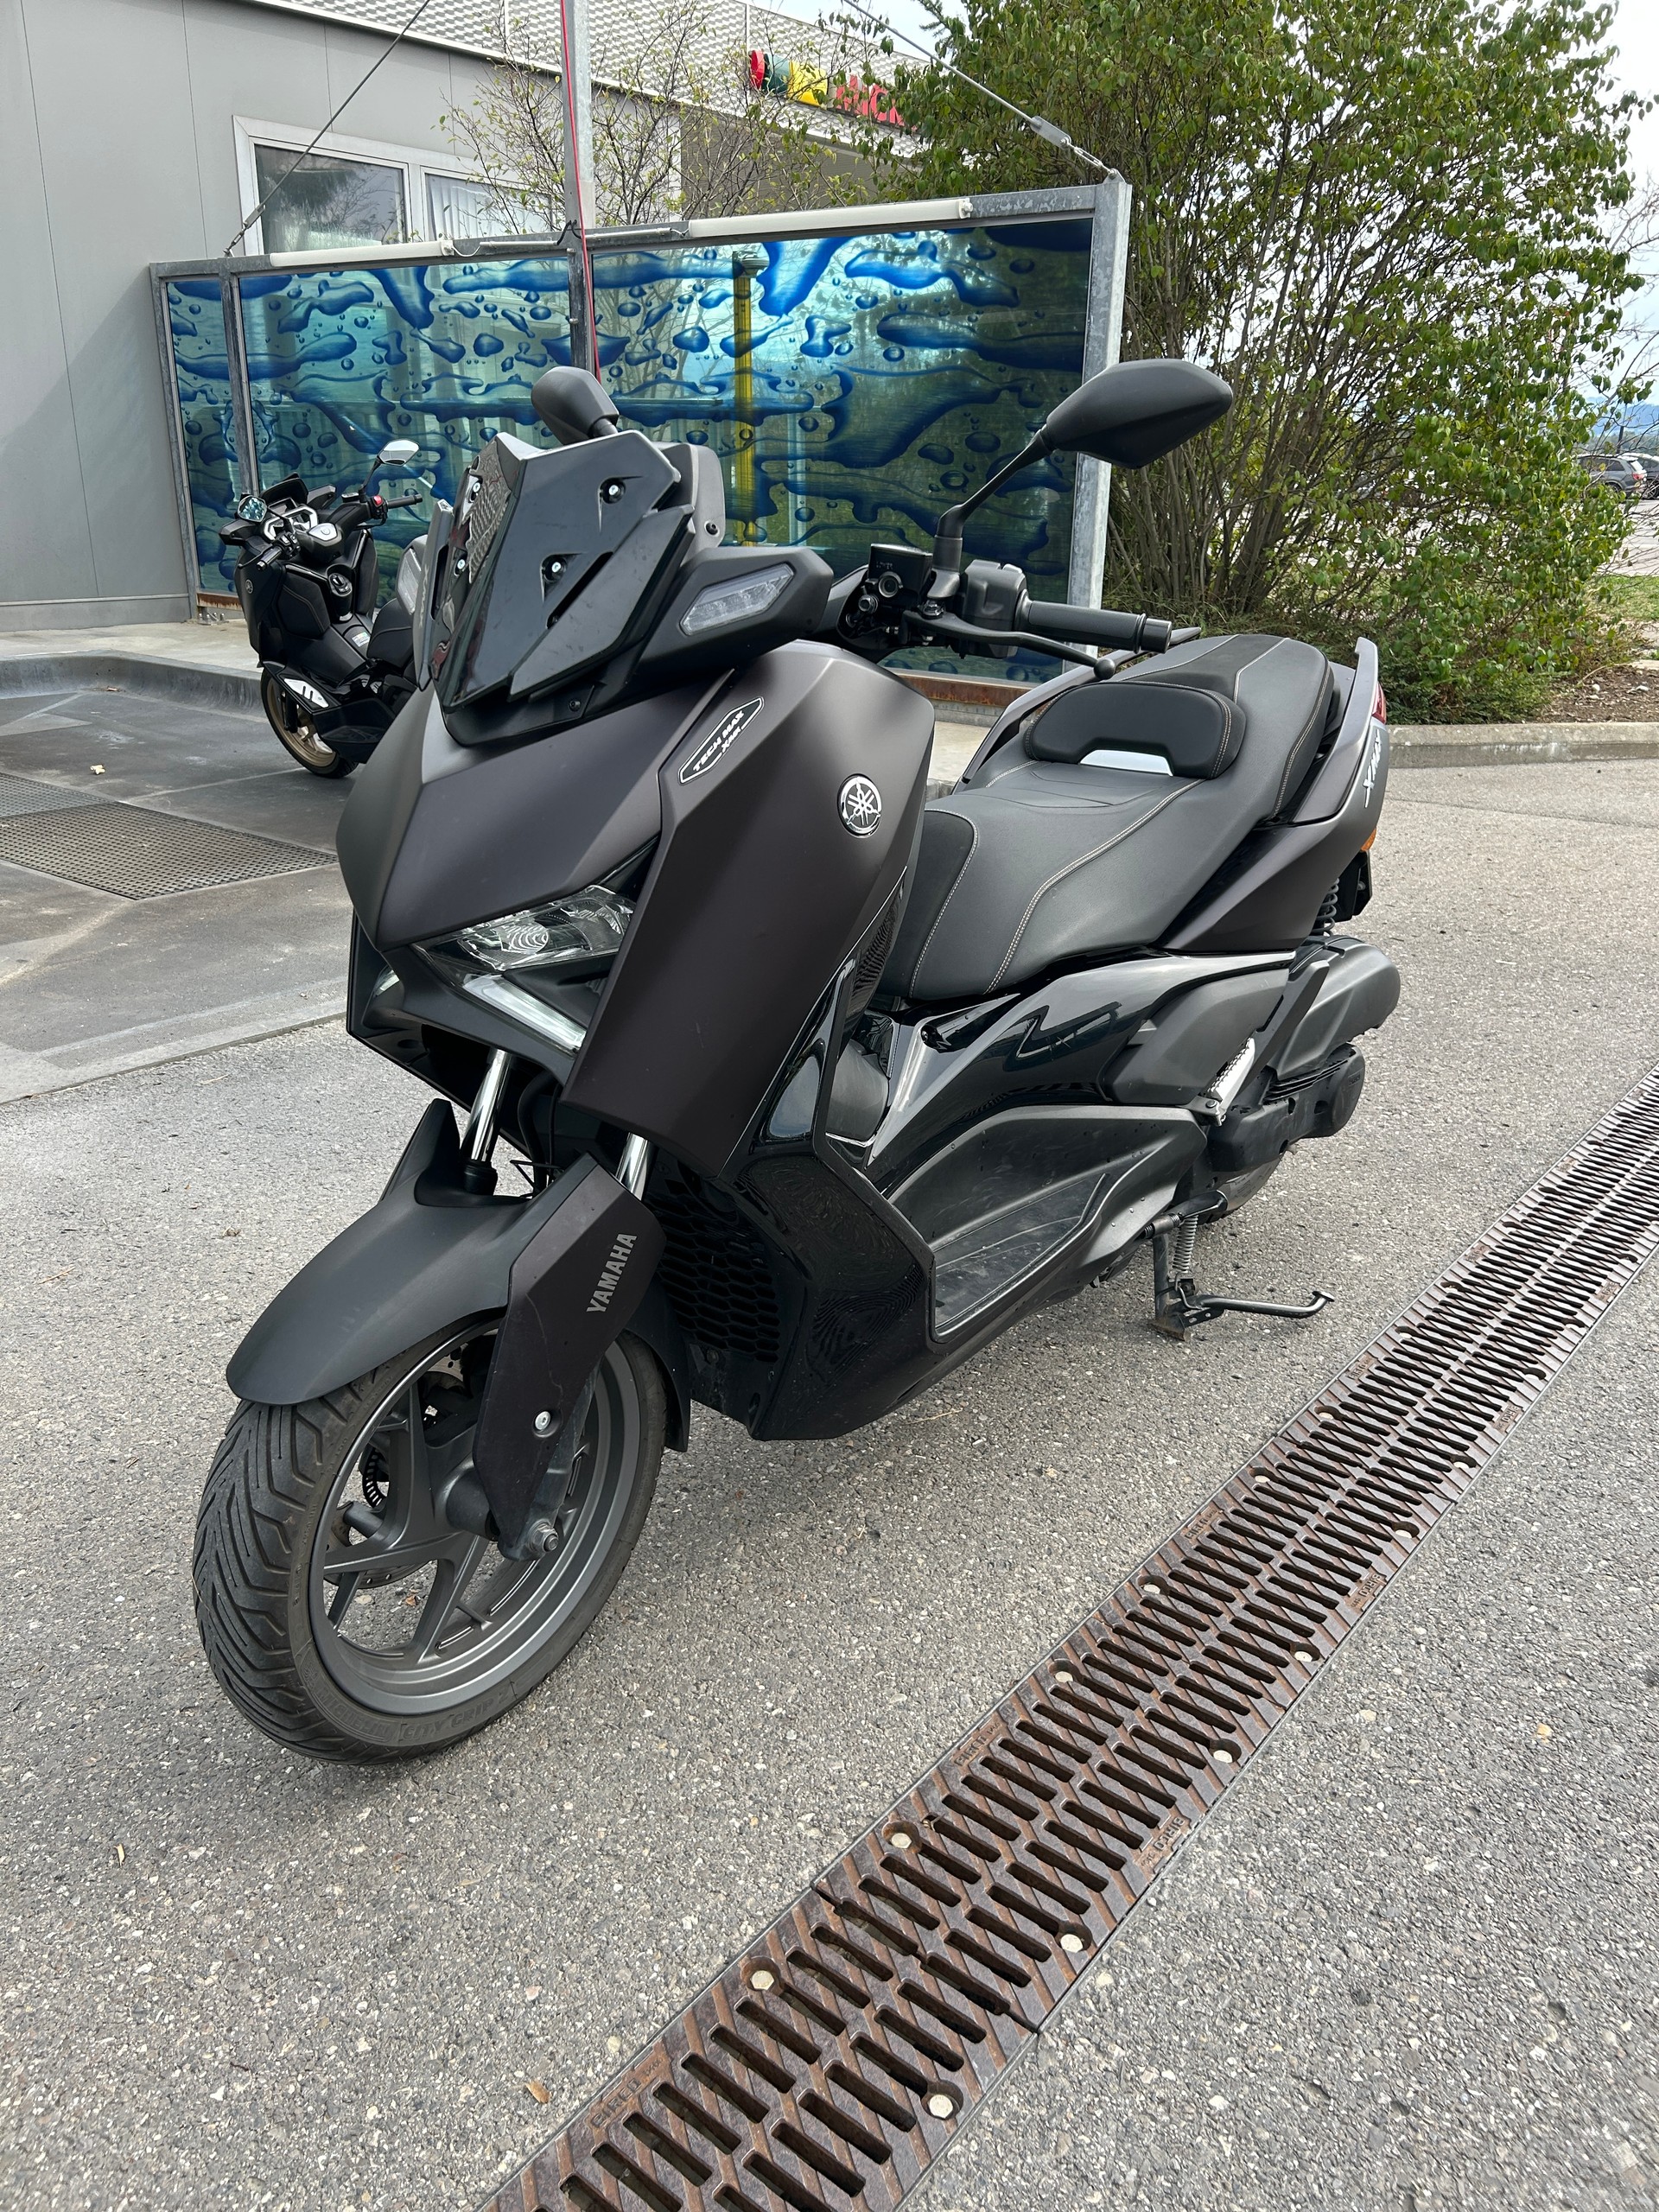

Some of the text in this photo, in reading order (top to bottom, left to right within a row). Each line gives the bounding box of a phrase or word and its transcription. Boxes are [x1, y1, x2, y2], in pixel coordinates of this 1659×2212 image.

[692, 709, 745, 772] TECH MAX
[586, 1233, 638, 1313] YAMAHA
[450, 1698, 495, 1728] GRIP
[590, 2077, 642, 2129] BIRCO
